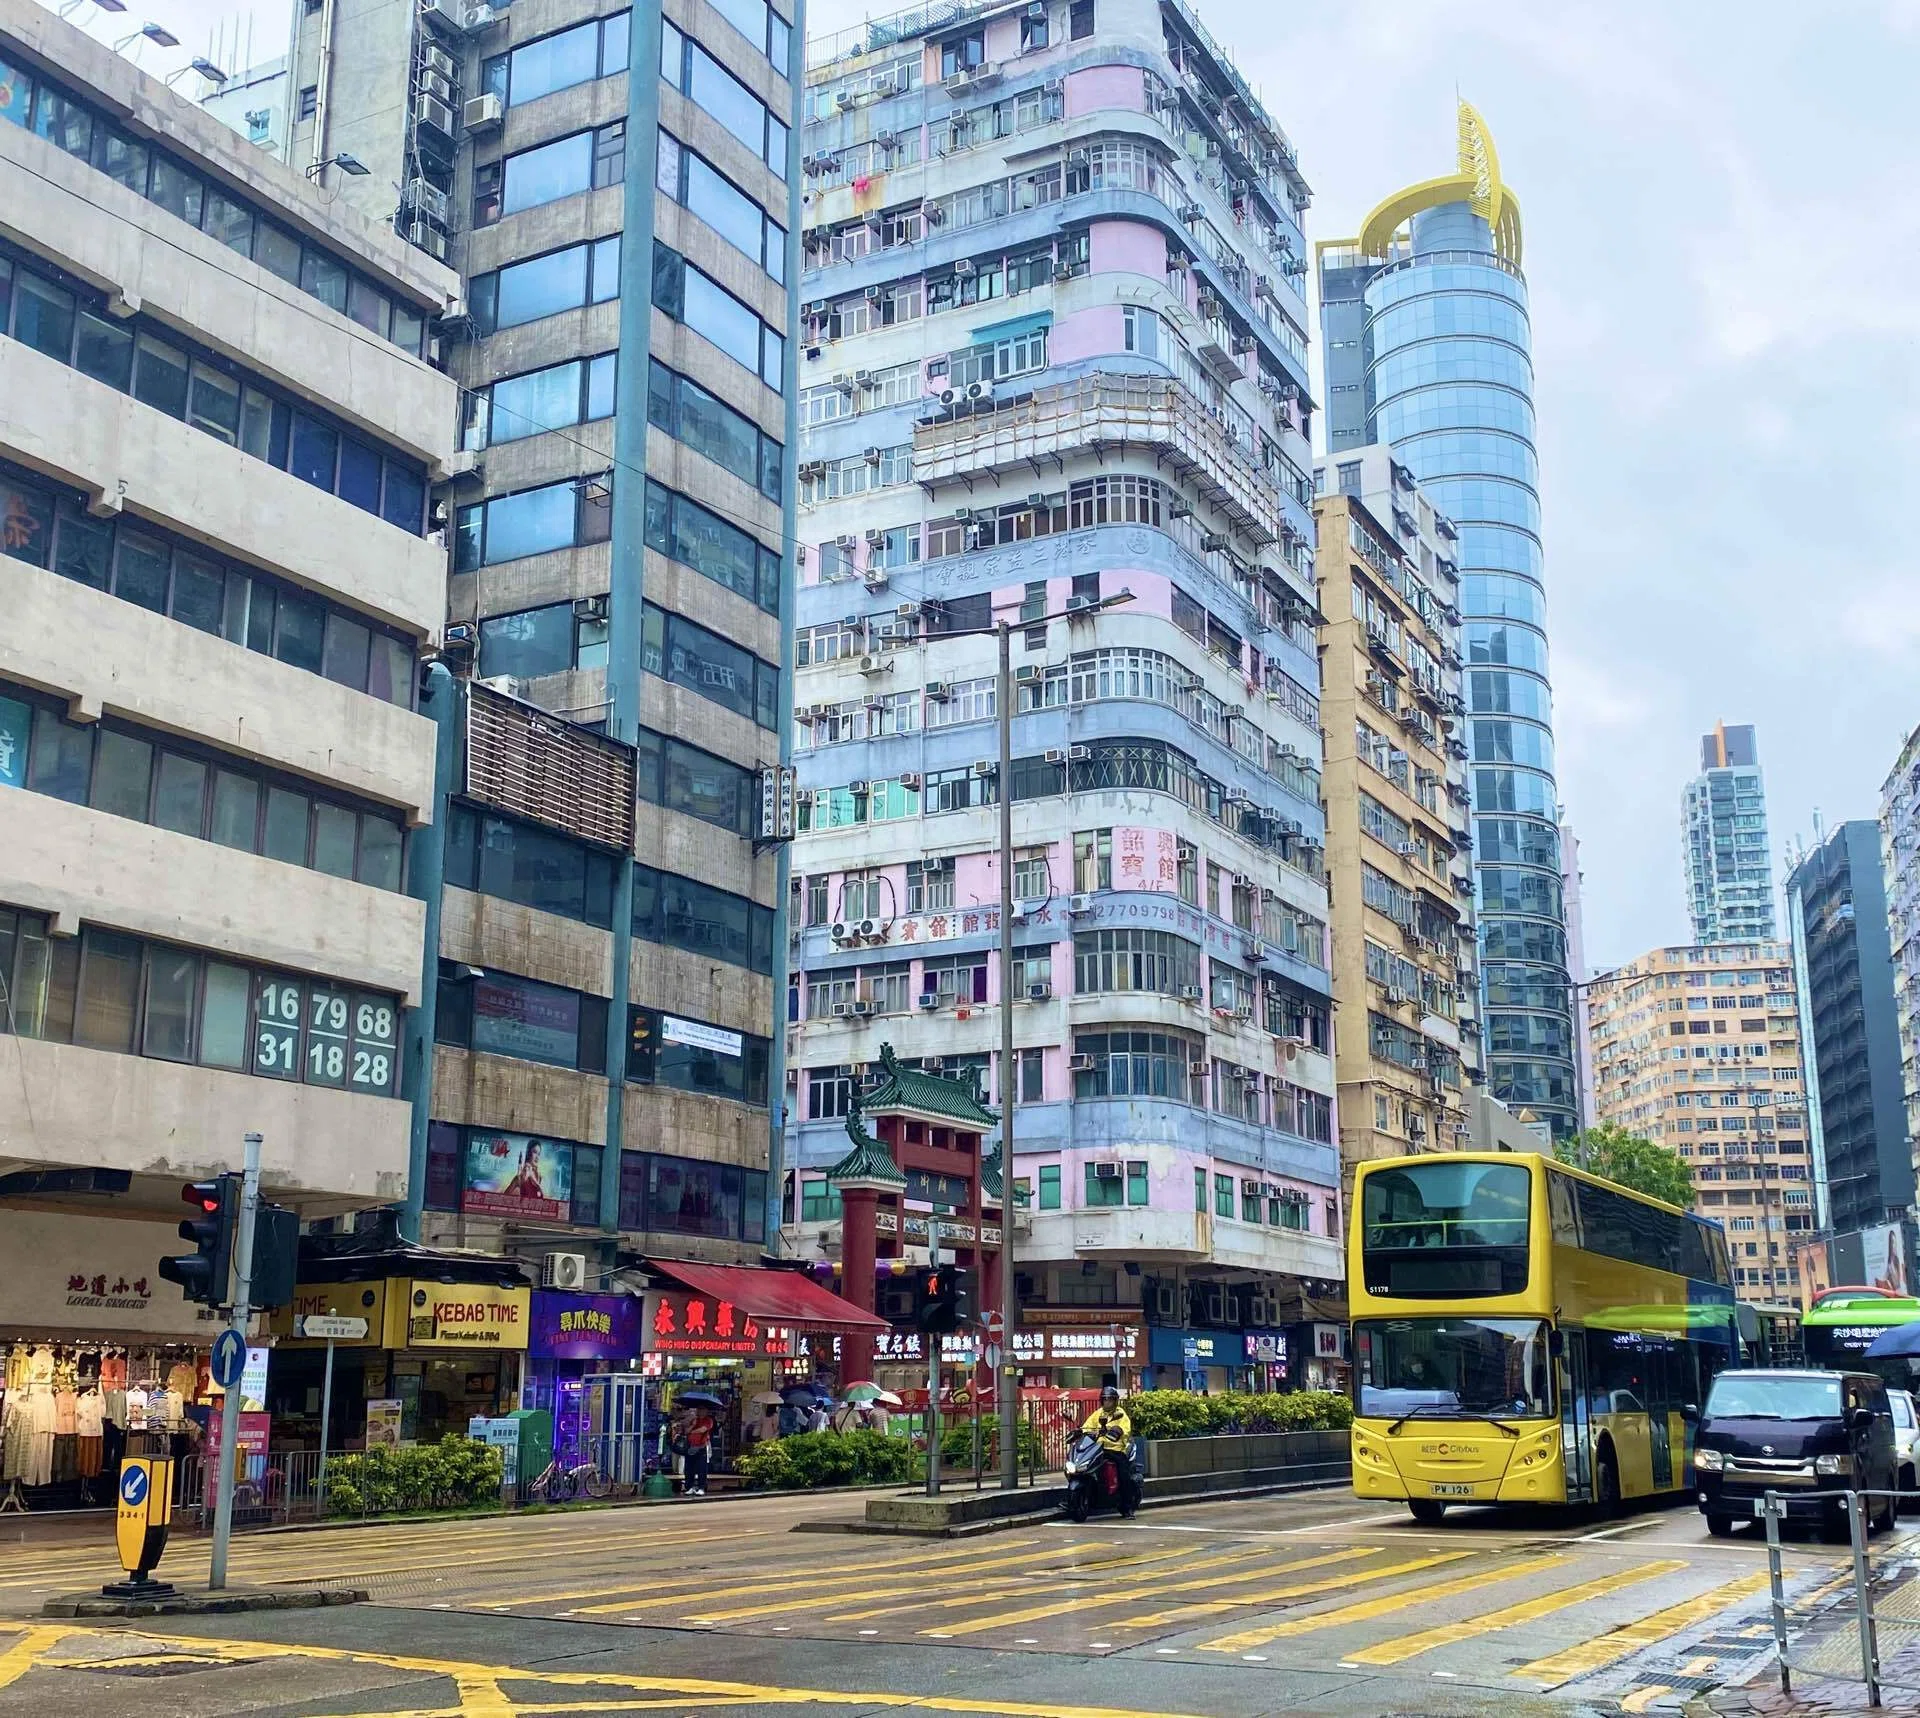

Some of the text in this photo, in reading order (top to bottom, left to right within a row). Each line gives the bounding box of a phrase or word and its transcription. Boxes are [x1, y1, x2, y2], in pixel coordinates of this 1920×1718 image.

[117, 479, 129, 495] 5
[1138, 879, 1165, 891] 4/F
[262, 983, 392, 1039] 16 79 68
[258, 1032, 388, 1086] 31 18 28
[67, 1274, 151, 1298] 地道小吃
[65, 1295, 102, 1307] LOCAL
[433, 1302, 519, 1324] KEBAB TIME
[654, 1339, 673, 1350] WING
[673, 1340, 690, 1350] HING
[731, 1341, 756, 1352] LIMITED
[1452, 1485, 1470, 1494] 126
[120, 1511, 145, 1519] 3341
